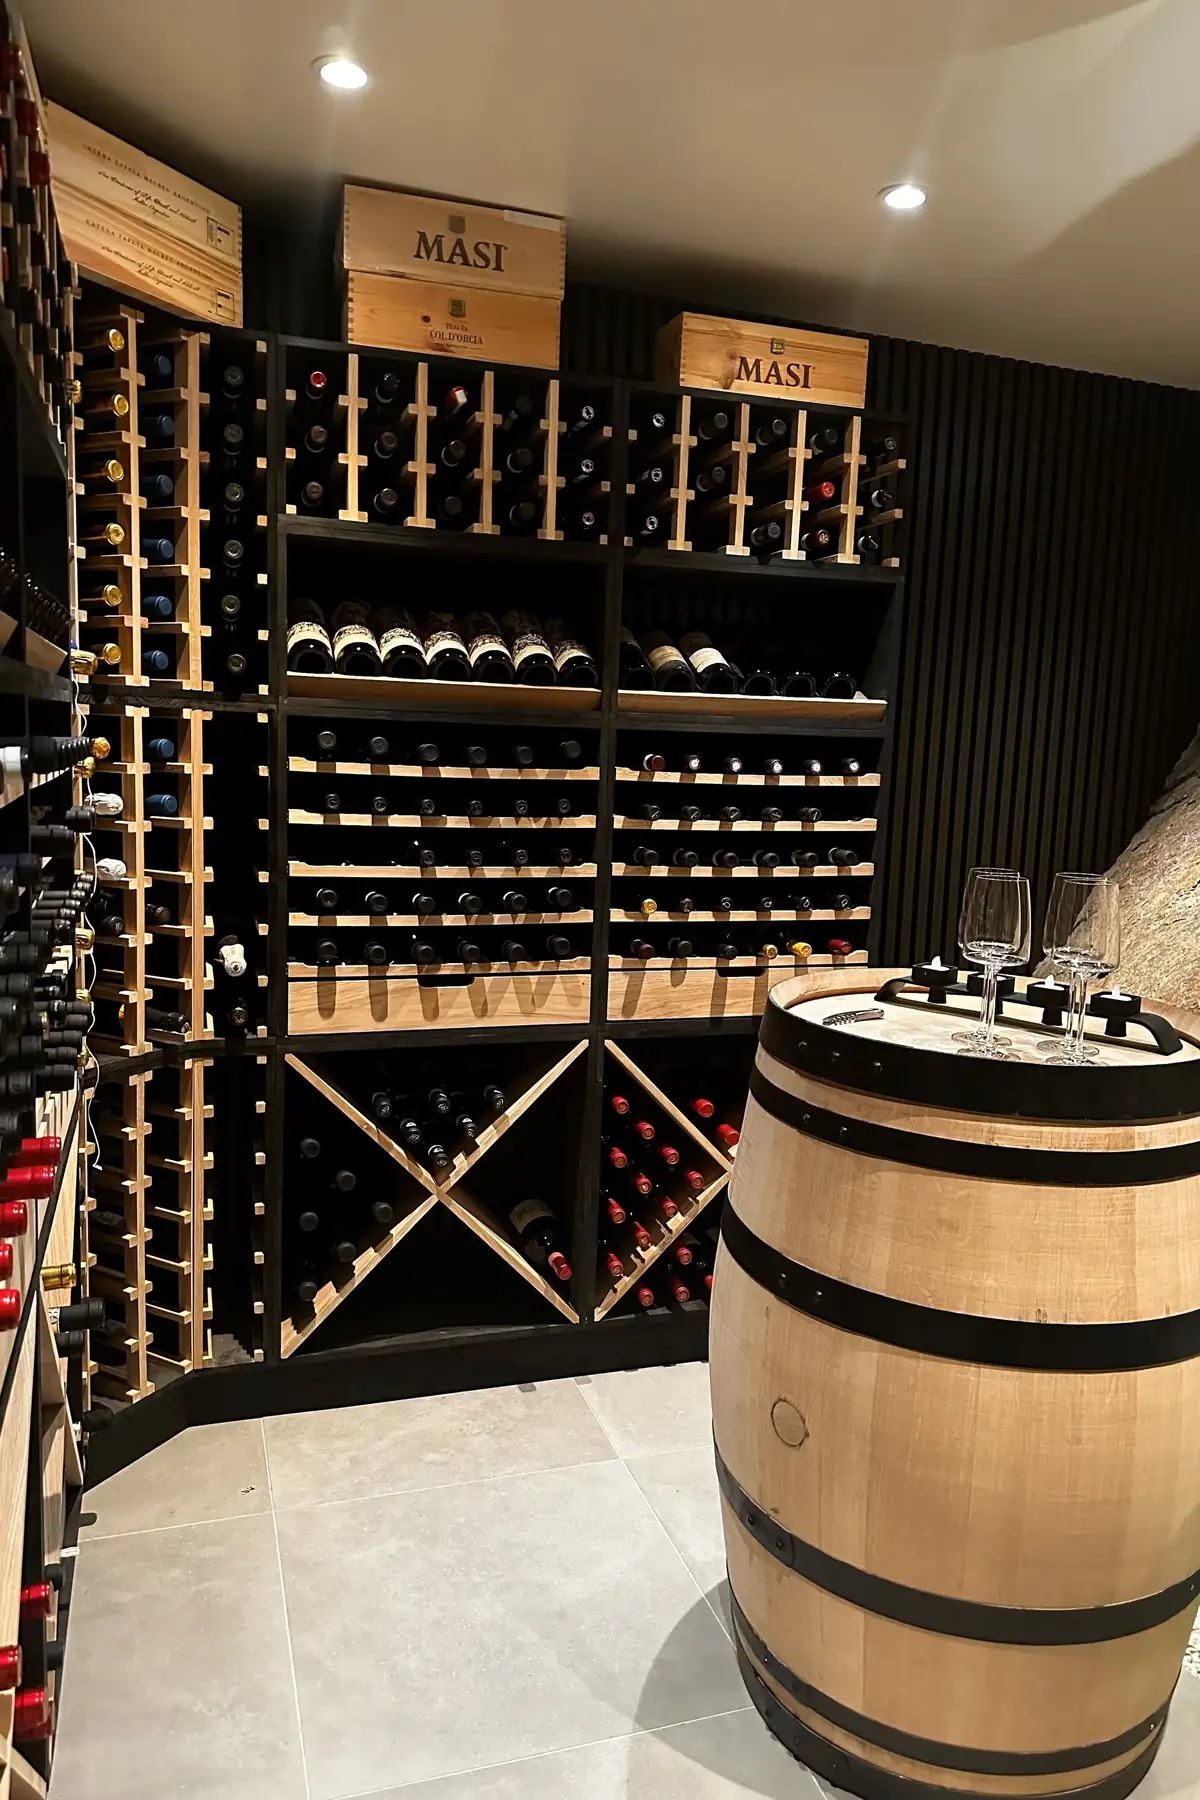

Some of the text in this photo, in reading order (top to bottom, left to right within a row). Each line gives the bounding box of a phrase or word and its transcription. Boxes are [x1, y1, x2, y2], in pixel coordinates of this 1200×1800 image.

[414, 231, 507, 271] MASI
[430, 330, 483, 345] COL D'ORCIA
[735, 356, 813, 389] MASI
